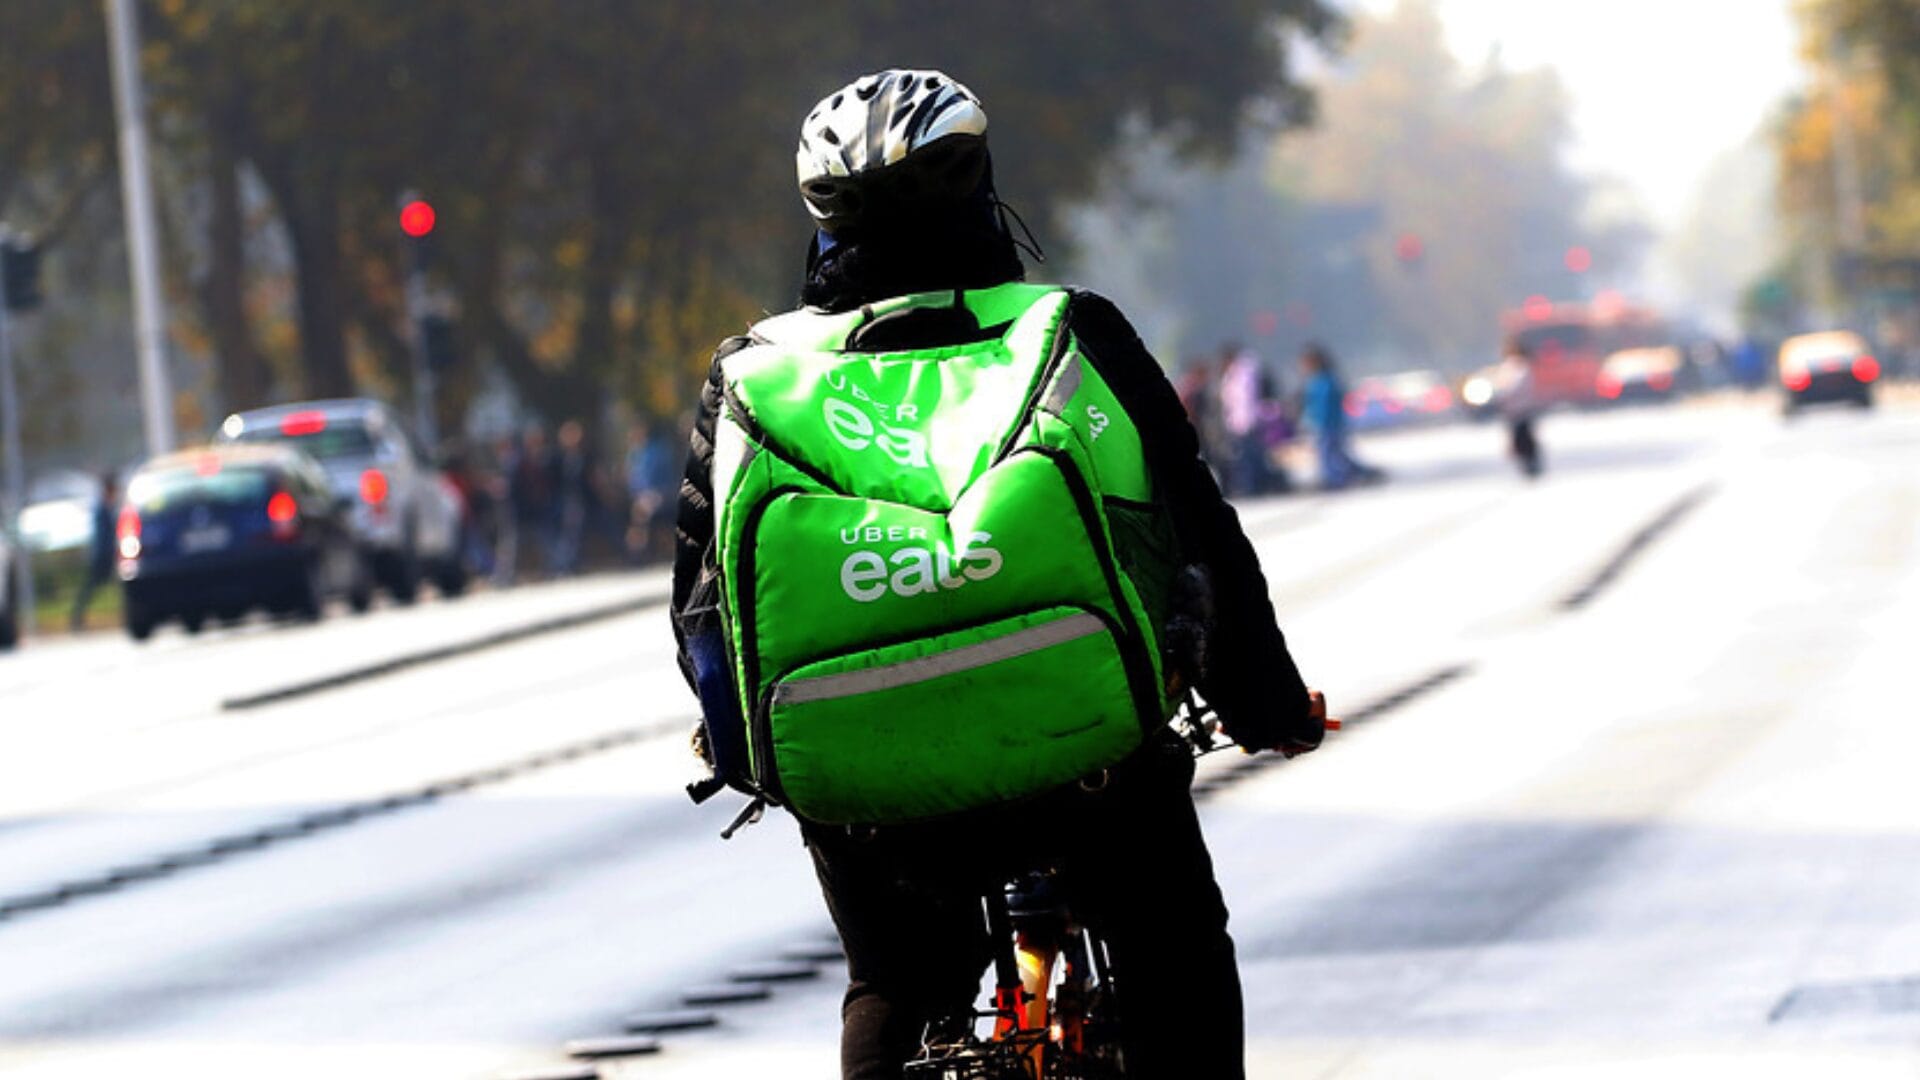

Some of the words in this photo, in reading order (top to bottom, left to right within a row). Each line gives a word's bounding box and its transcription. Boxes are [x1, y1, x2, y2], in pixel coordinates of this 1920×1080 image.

[823, 397, 929, 468] ea
[840, 526, 928, 544] UBER
[840, 531, 1003, 602] eats
